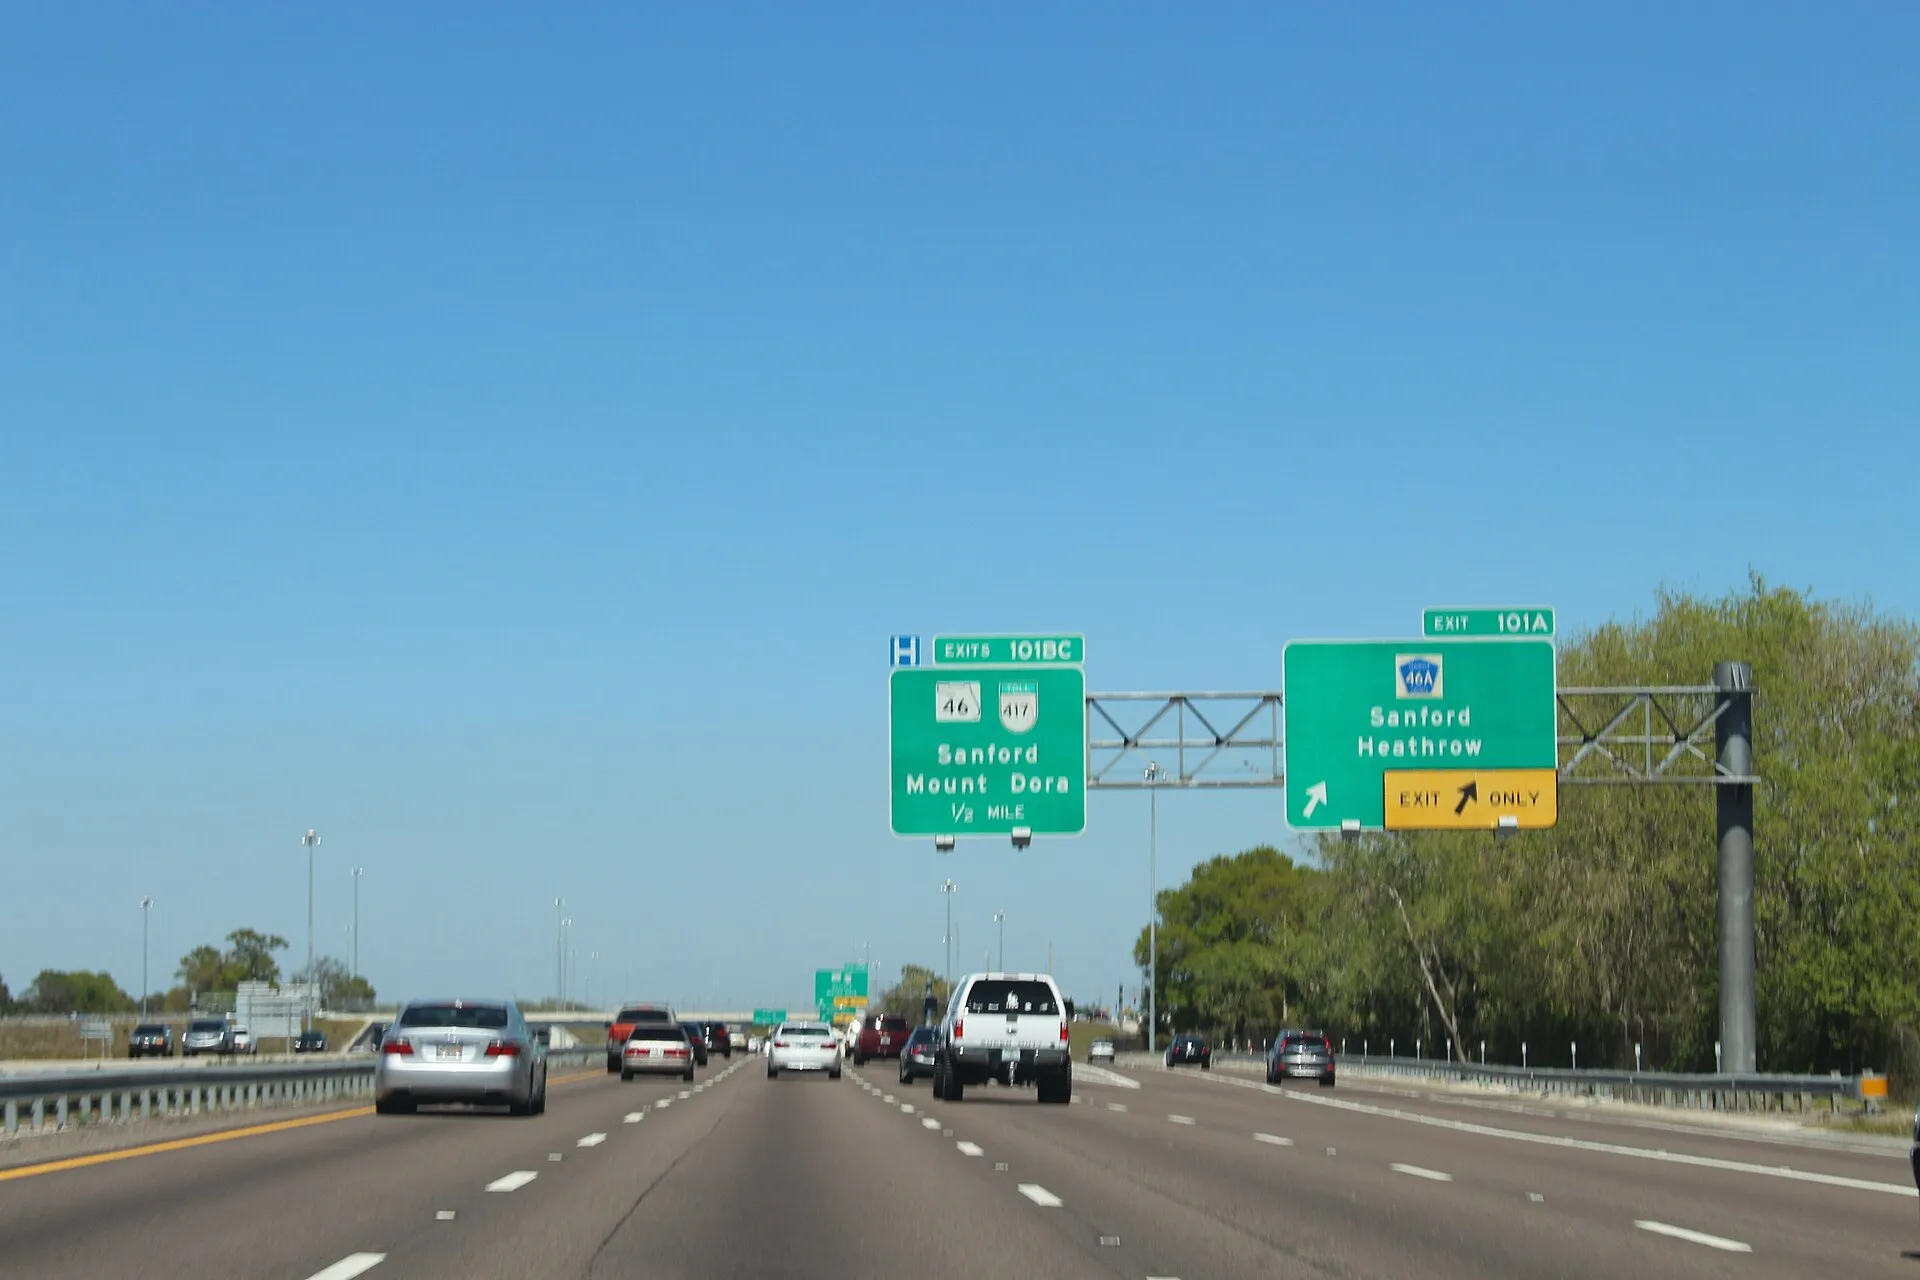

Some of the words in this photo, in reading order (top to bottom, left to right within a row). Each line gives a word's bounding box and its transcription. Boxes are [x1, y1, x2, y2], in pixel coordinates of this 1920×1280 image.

[1434, 615, 1468, 631] EXIT
[1497, 612, 1548, 632] 101A
[894, 636, 917, 666] H
[944, 643, 990, 659] EXITS
[1010, 640, 1072, 660] 101BC
[1405, 670, 1433, 688] 46A
[943, 697, 969, 715] 46
[1003, 702, 1029, 719] 417
[1370, 705, 1471, 728] Sanford
[937, 743, 1038, 765] Sanford
[1358, 736, 1482, 757] Heathrow
[906, 773, 987, 795] Mount
[1011, 772, 1069, 794] Dora
[1400, 791, 1440, 807] EXIT
[1489, 790, 1539, 807] ONLY
[988, 804, 1025, 820] MILE
